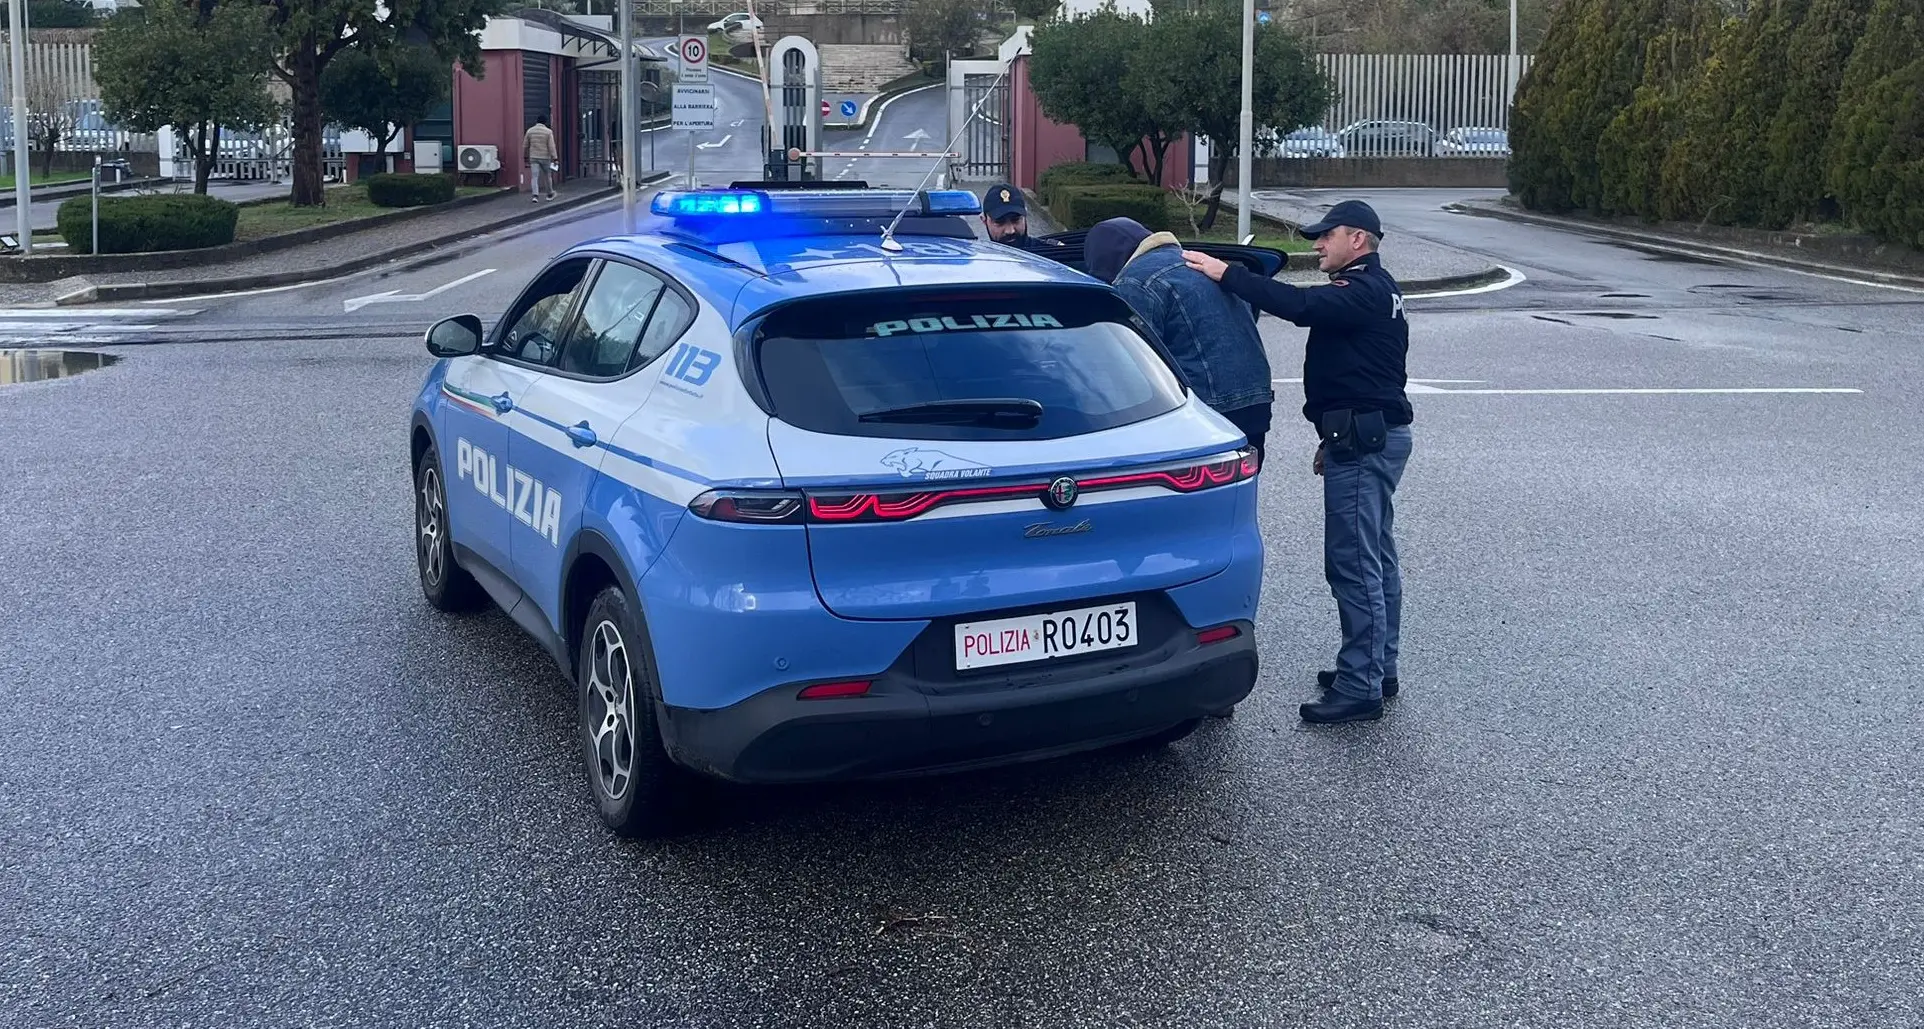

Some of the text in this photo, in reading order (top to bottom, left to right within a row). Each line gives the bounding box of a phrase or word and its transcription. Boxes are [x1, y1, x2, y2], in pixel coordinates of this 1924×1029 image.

[688, 45, 700, 57] 10
[874, 314, 1064, 337] POLIZIA
[665, 342, 722, 387] 113
[924, 468, 992, 480] SQUADRA VOLANTE
[457, 437, 563, 548] POLIZIA
[964, 608, 1130, 658] POLIZIA R0403
